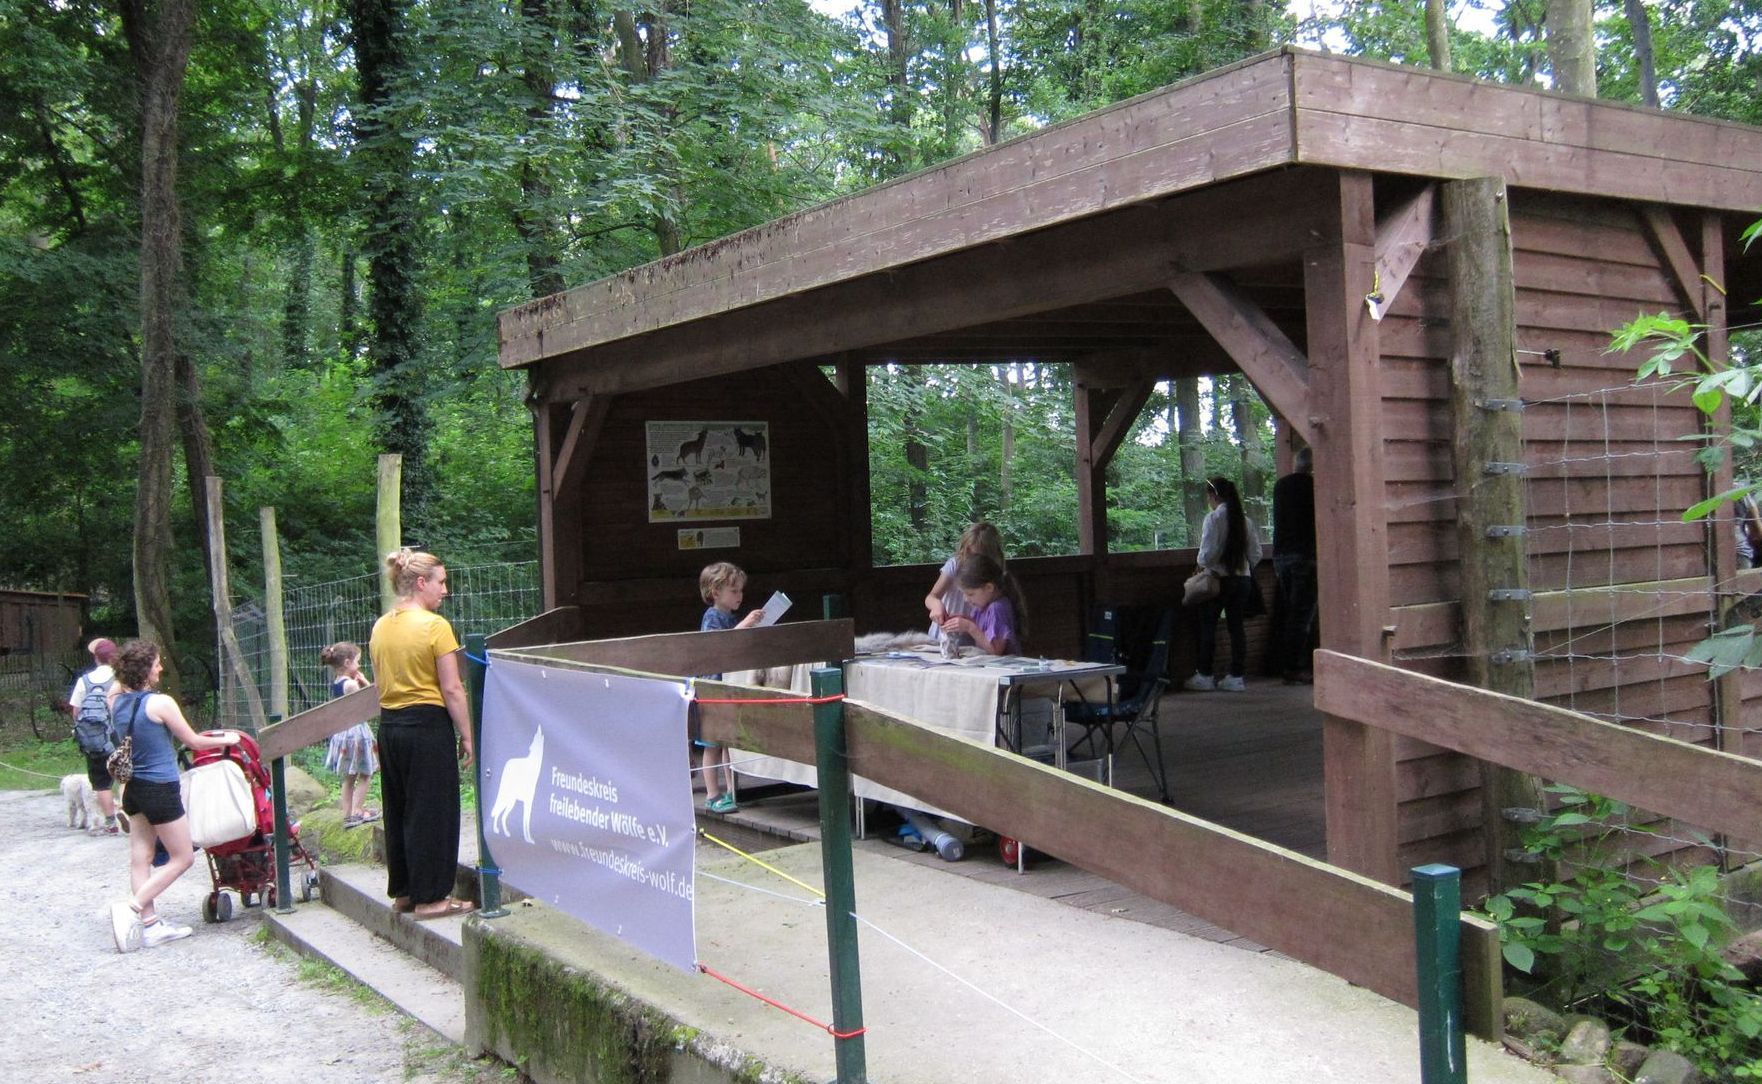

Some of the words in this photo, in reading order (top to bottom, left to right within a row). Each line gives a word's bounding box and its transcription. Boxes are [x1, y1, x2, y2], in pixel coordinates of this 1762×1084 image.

[552, 766, 618, 803] Freundeskreis
[549, 793, 609, 830] freilebender
[611, 811, 646, 840] Wölfe
[648, 824, 669, 848] e.V.
[551, 839, 693, 901] www.freundeskreis-wolf.de
